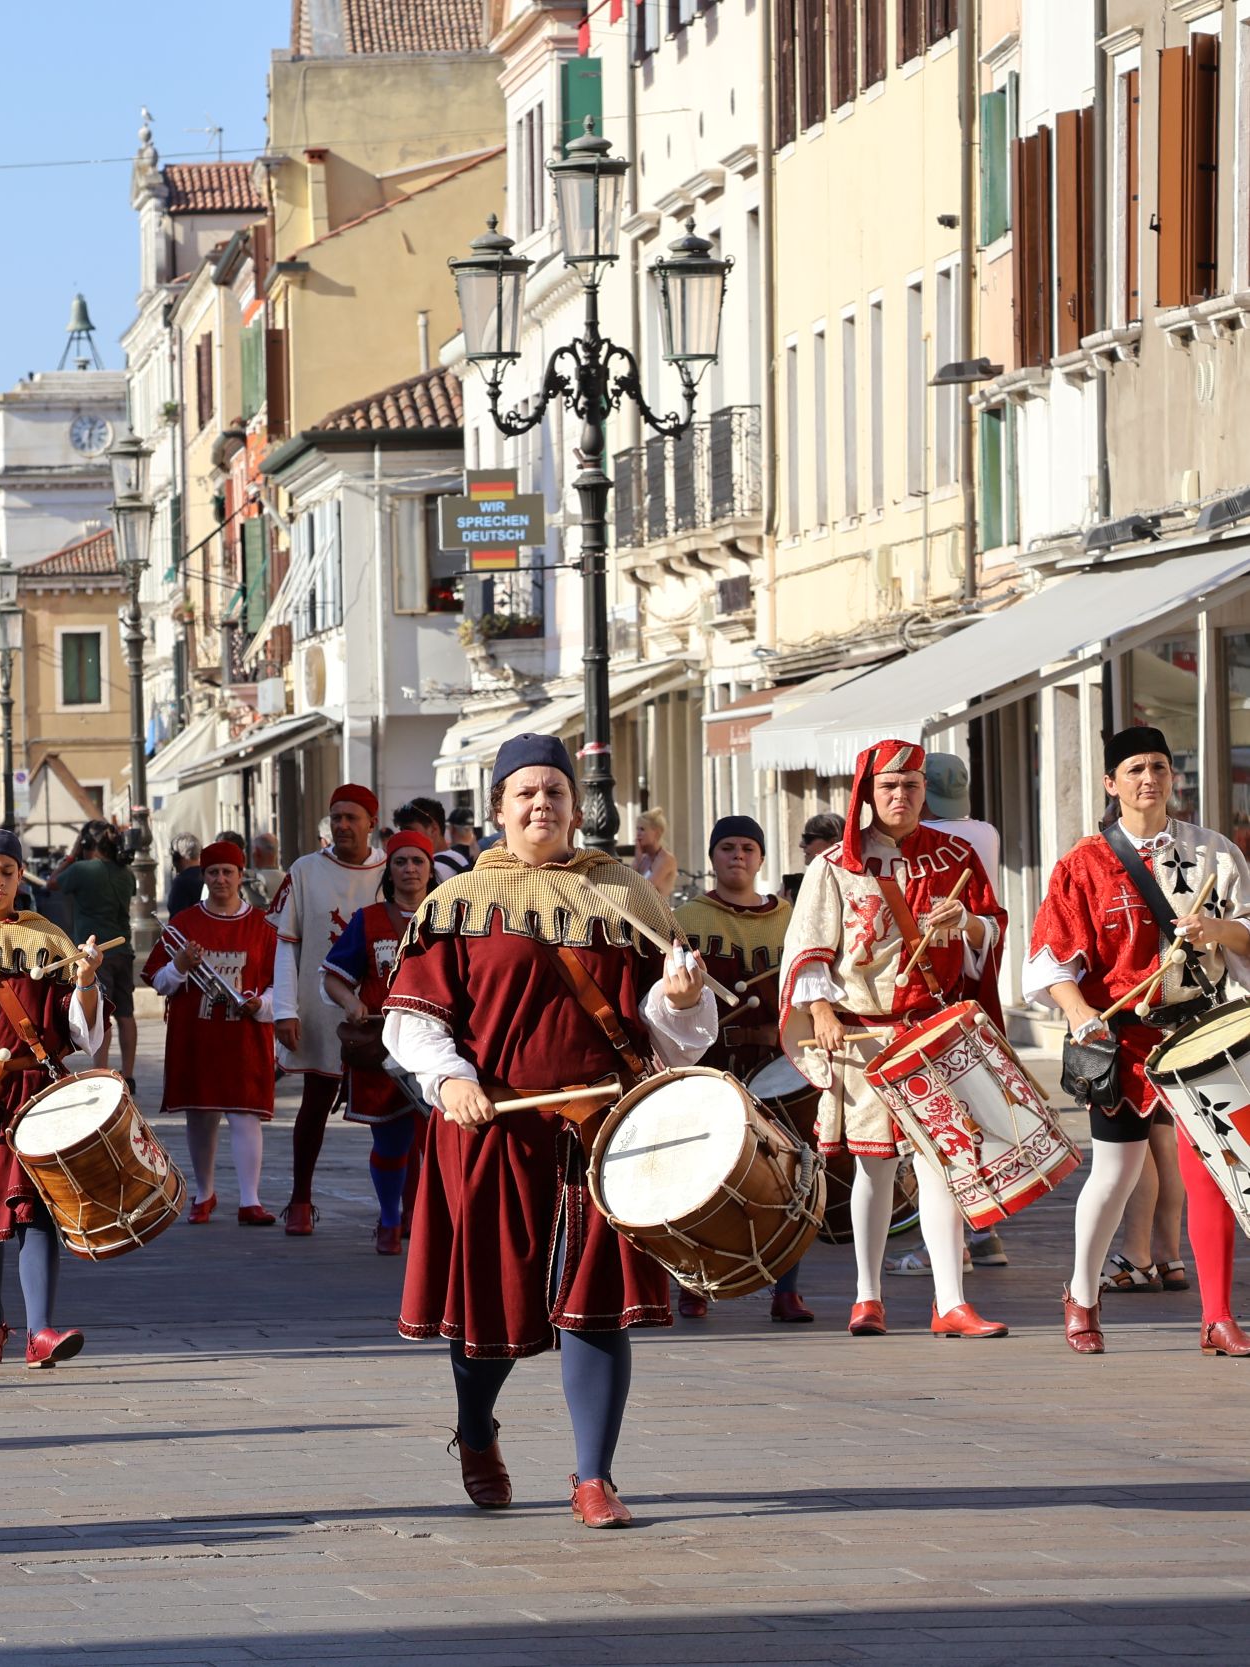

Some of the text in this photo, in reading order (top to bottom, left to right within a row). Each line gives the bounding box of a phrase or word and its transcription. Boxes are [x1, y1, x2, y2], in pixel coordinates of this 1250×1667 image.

[479, 501, 506, 512] WIR
[456, 515, 530, 528] SPRECHEN
[462, 529, 526, 542] DEUTSCH
